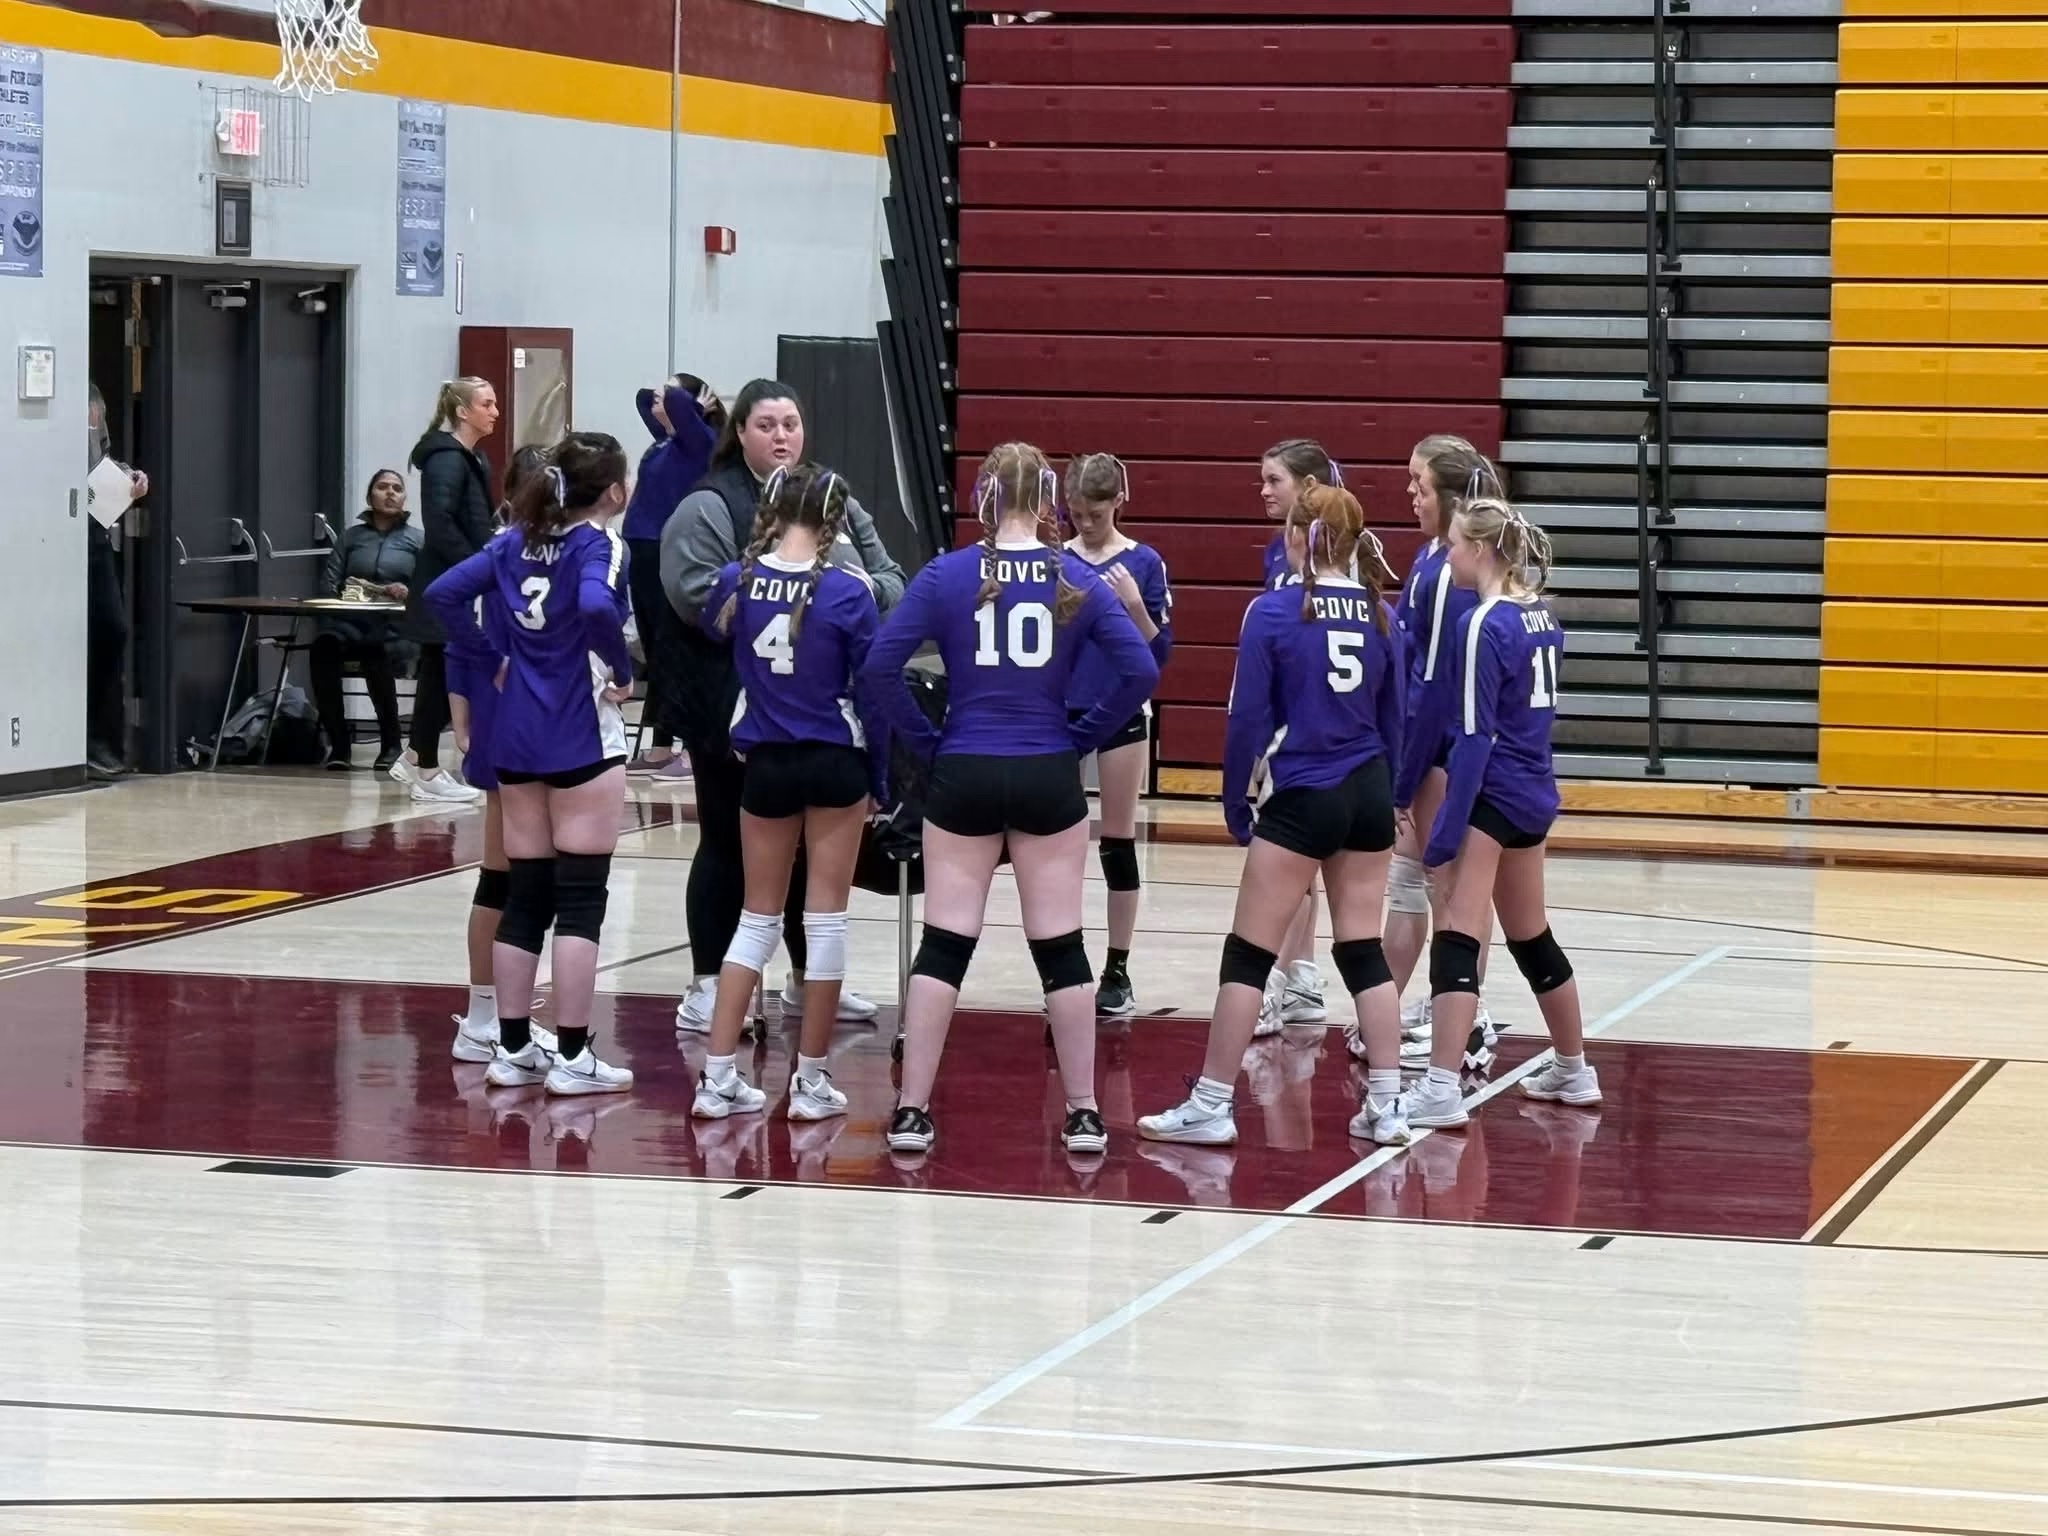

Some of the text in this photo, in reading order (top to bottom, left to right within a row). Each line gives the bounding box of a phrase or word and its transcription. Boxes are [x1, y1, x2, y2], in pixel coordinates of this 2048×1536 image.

[514, 576, 551, 630] 3
[752, 614, 794, 674] 4
[974, 602, 1053, 667] 10
[1327, 631, 1364, 693] 5
